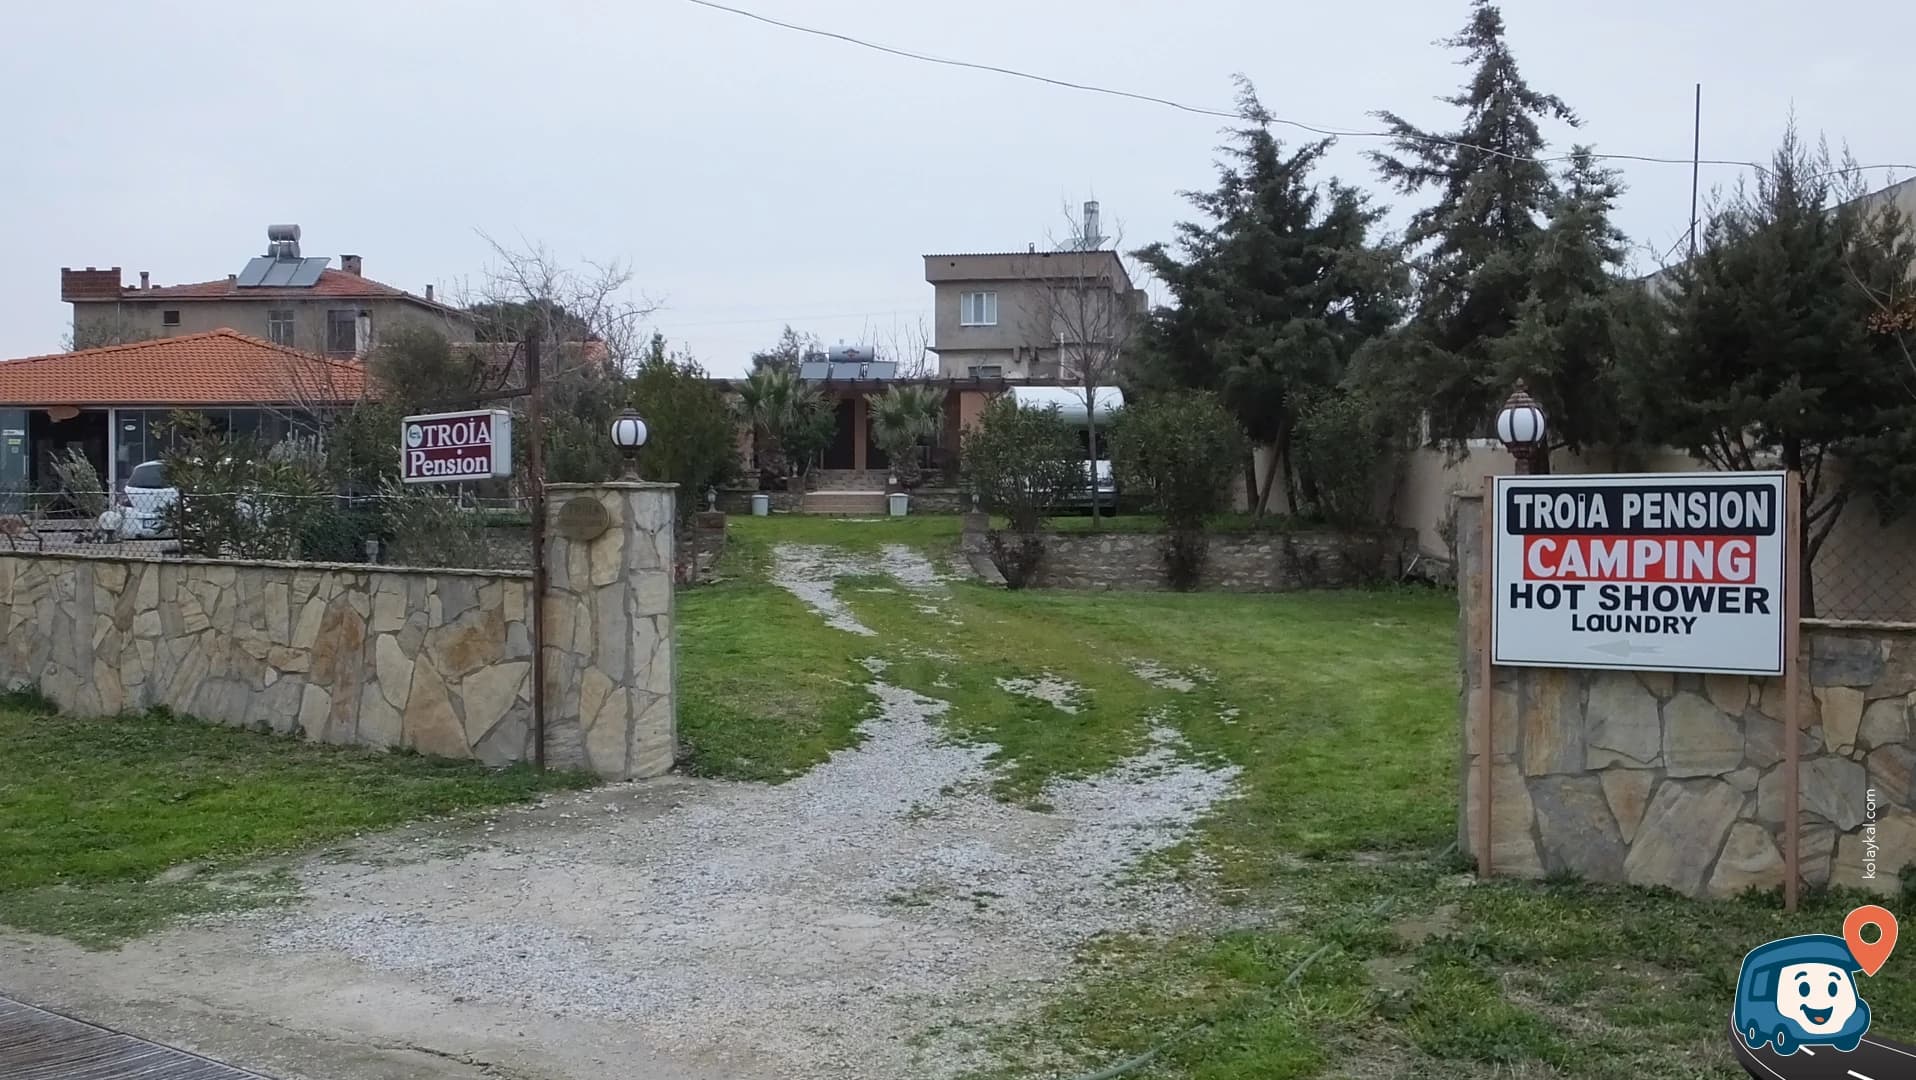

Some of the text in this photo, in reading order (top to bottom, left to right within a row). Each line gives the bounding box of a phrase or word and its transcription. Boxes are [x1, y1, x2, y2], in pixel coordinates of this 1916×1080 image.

[410, 449, 488, 476] Pension
[1622, 491, 1768, 529] PENSION
[1528, 538, 1751, 581] CAMPING
[1510, 583, 1770, 614] HOT SHOWER
